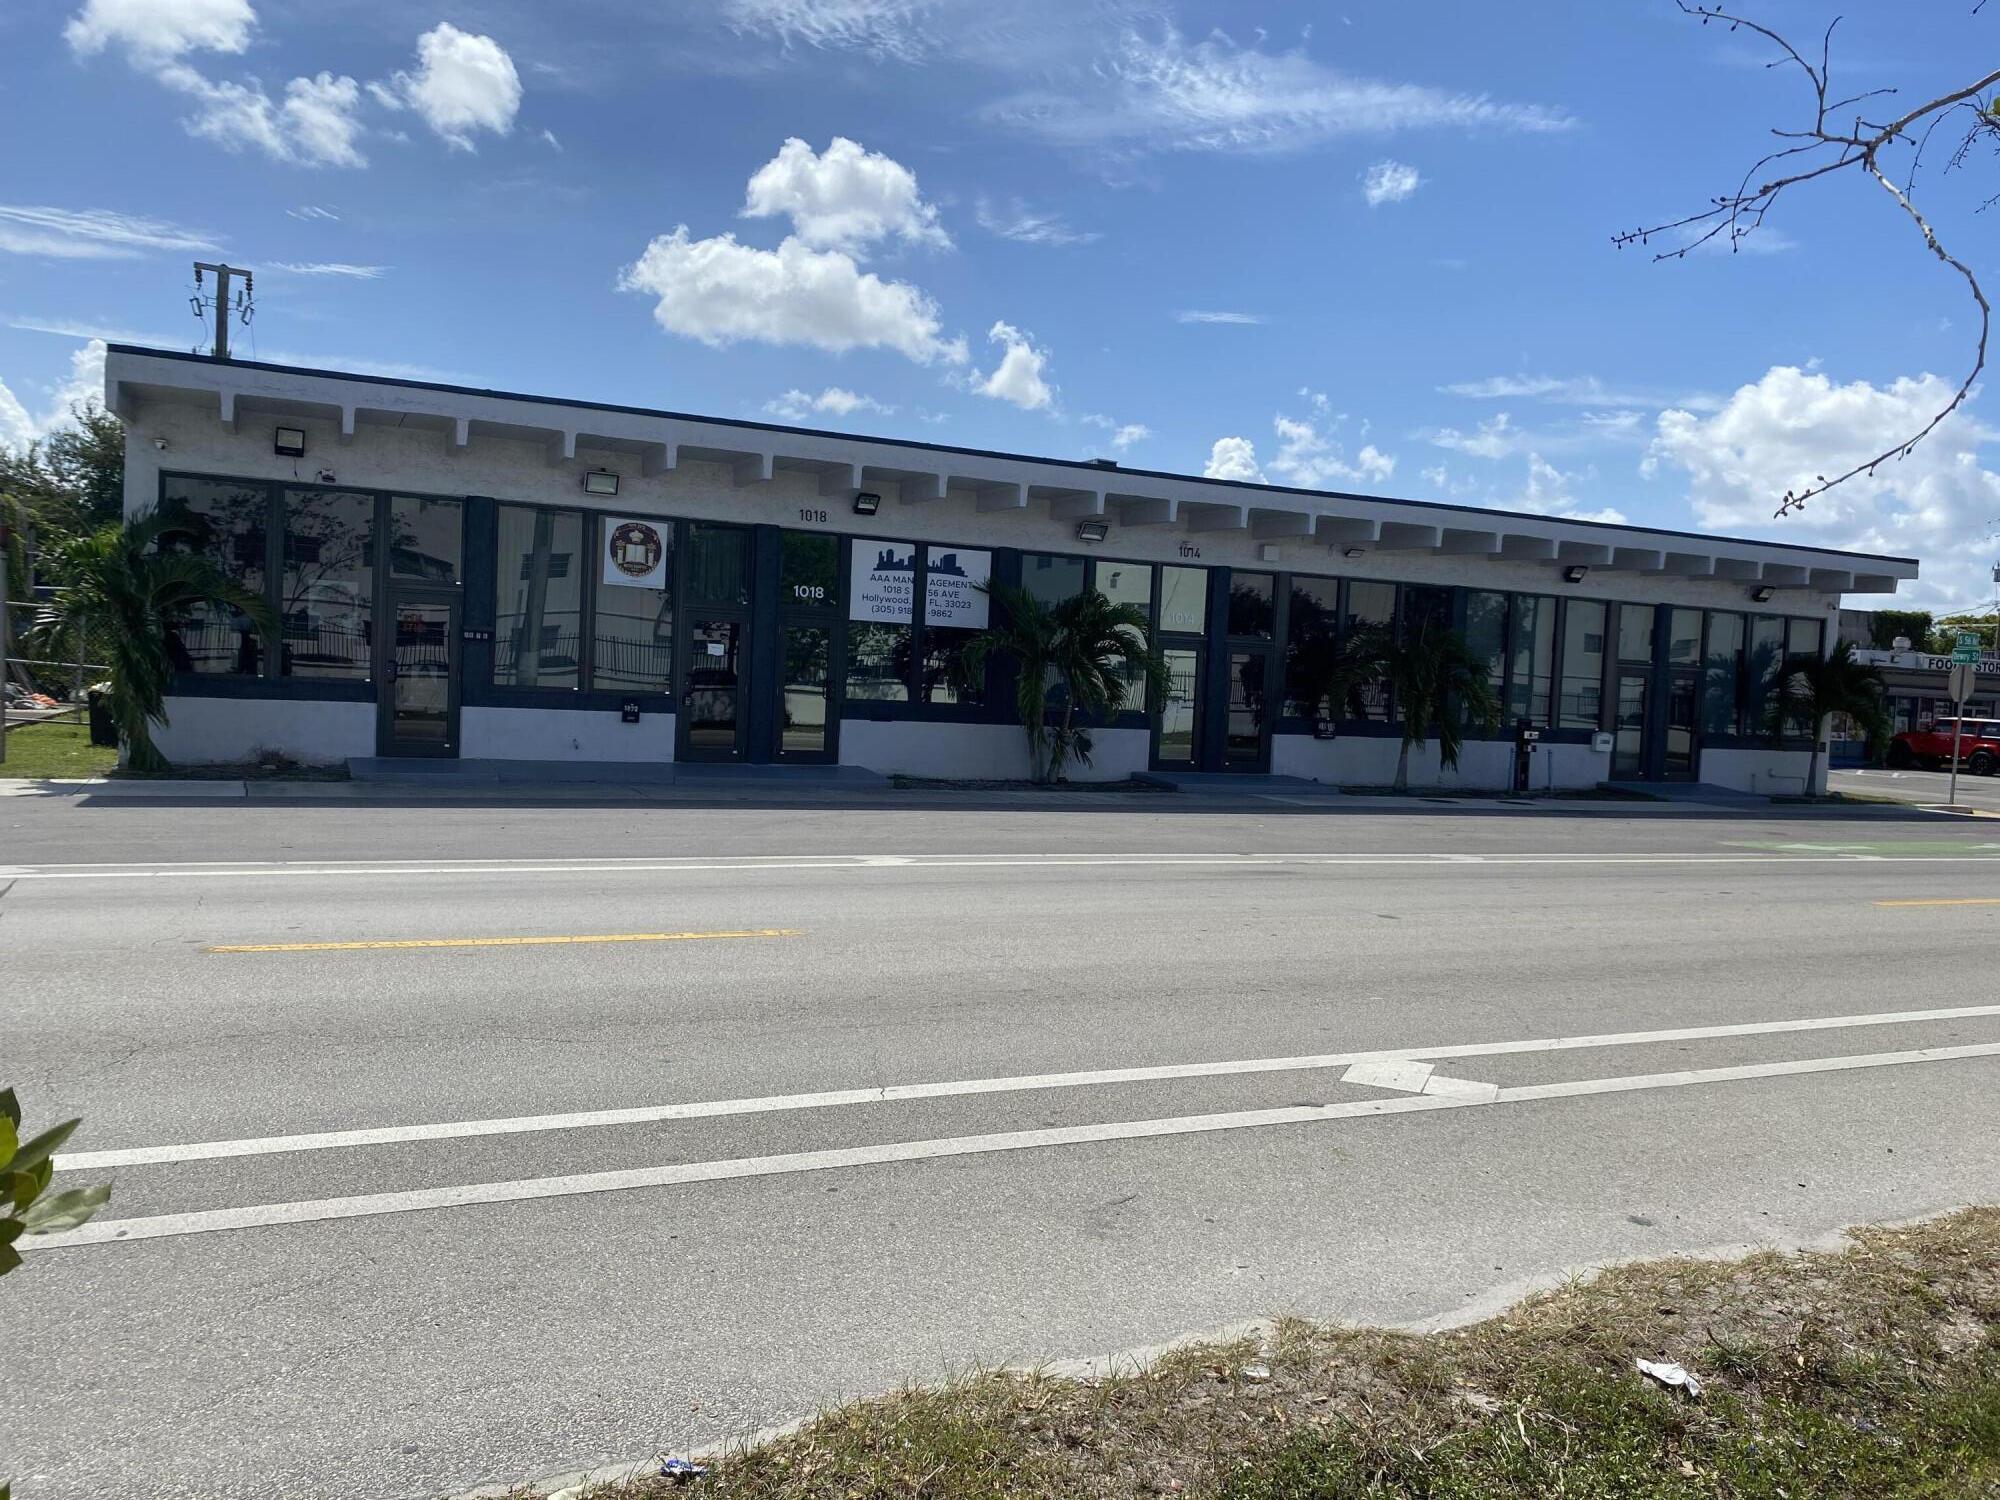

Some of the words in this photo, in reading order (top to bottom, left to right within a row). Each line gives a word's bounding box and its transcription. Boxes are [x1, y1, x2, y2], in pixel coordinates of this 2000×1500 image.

[799, 509, 827, 522] 1018
[1179, 546, 1200, 558] 1014
[870, 573, 890, 583] AAA
[793, 585, 824, 598] 1018
[883, 585, 902, 594] 1018
[904, 586, 911, 595] S
[928, 589, 938, 597] 56
[941, 590, 960, 599] AVE
[862, 593, 912, 605] Hollywood,
[944, 600, 972, 609] 33023
[871, 604, 896, 615] (305)
[898, 606, 913, 615] 918
